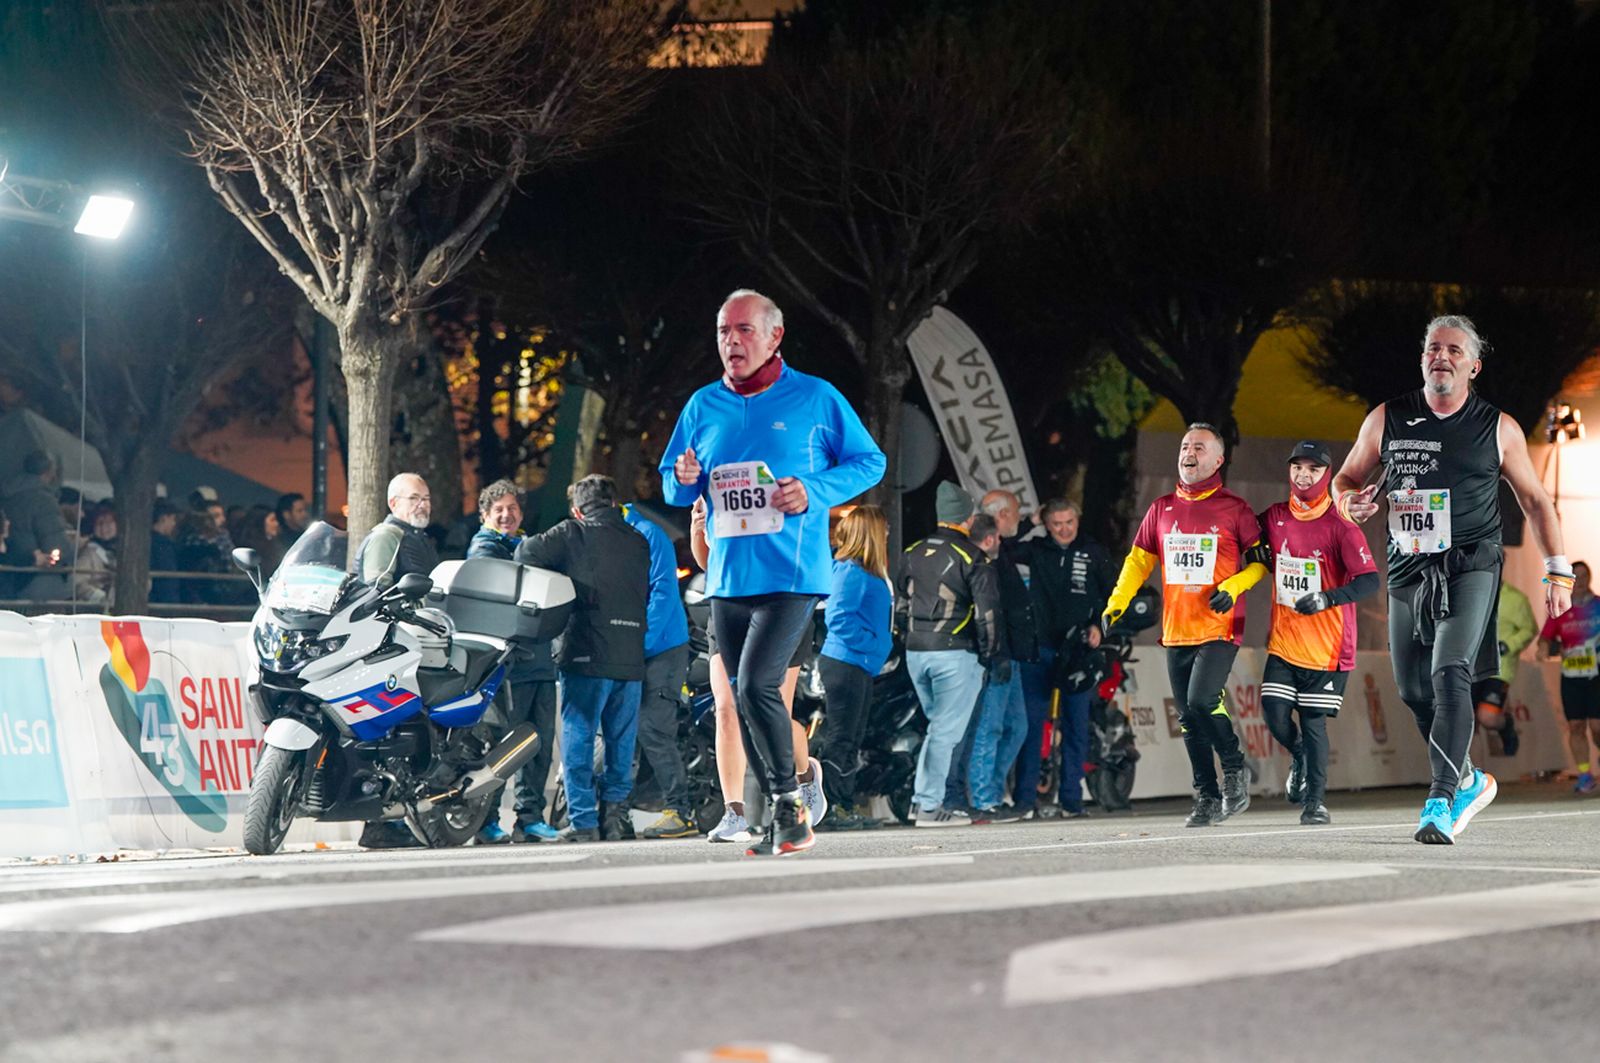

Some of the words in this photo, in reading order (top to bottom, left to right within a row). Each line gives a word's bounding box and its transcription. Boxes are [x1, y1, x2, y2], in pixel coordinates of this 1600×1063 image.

[957, 346, 1033, 509] APEMASA
[721, 487, 766, 511] 1663
[1399, 512, 1434, 532] 1764
[1173, 552, 1205, 568] 4415
[1282, 574, 1309, 592] 4414
[180, 676, 243, 731] SAN
[0, 711, 51, 756] lsa
[140, 702, 186, 787] 43
[1246, 723, 1286, 759] ANT
